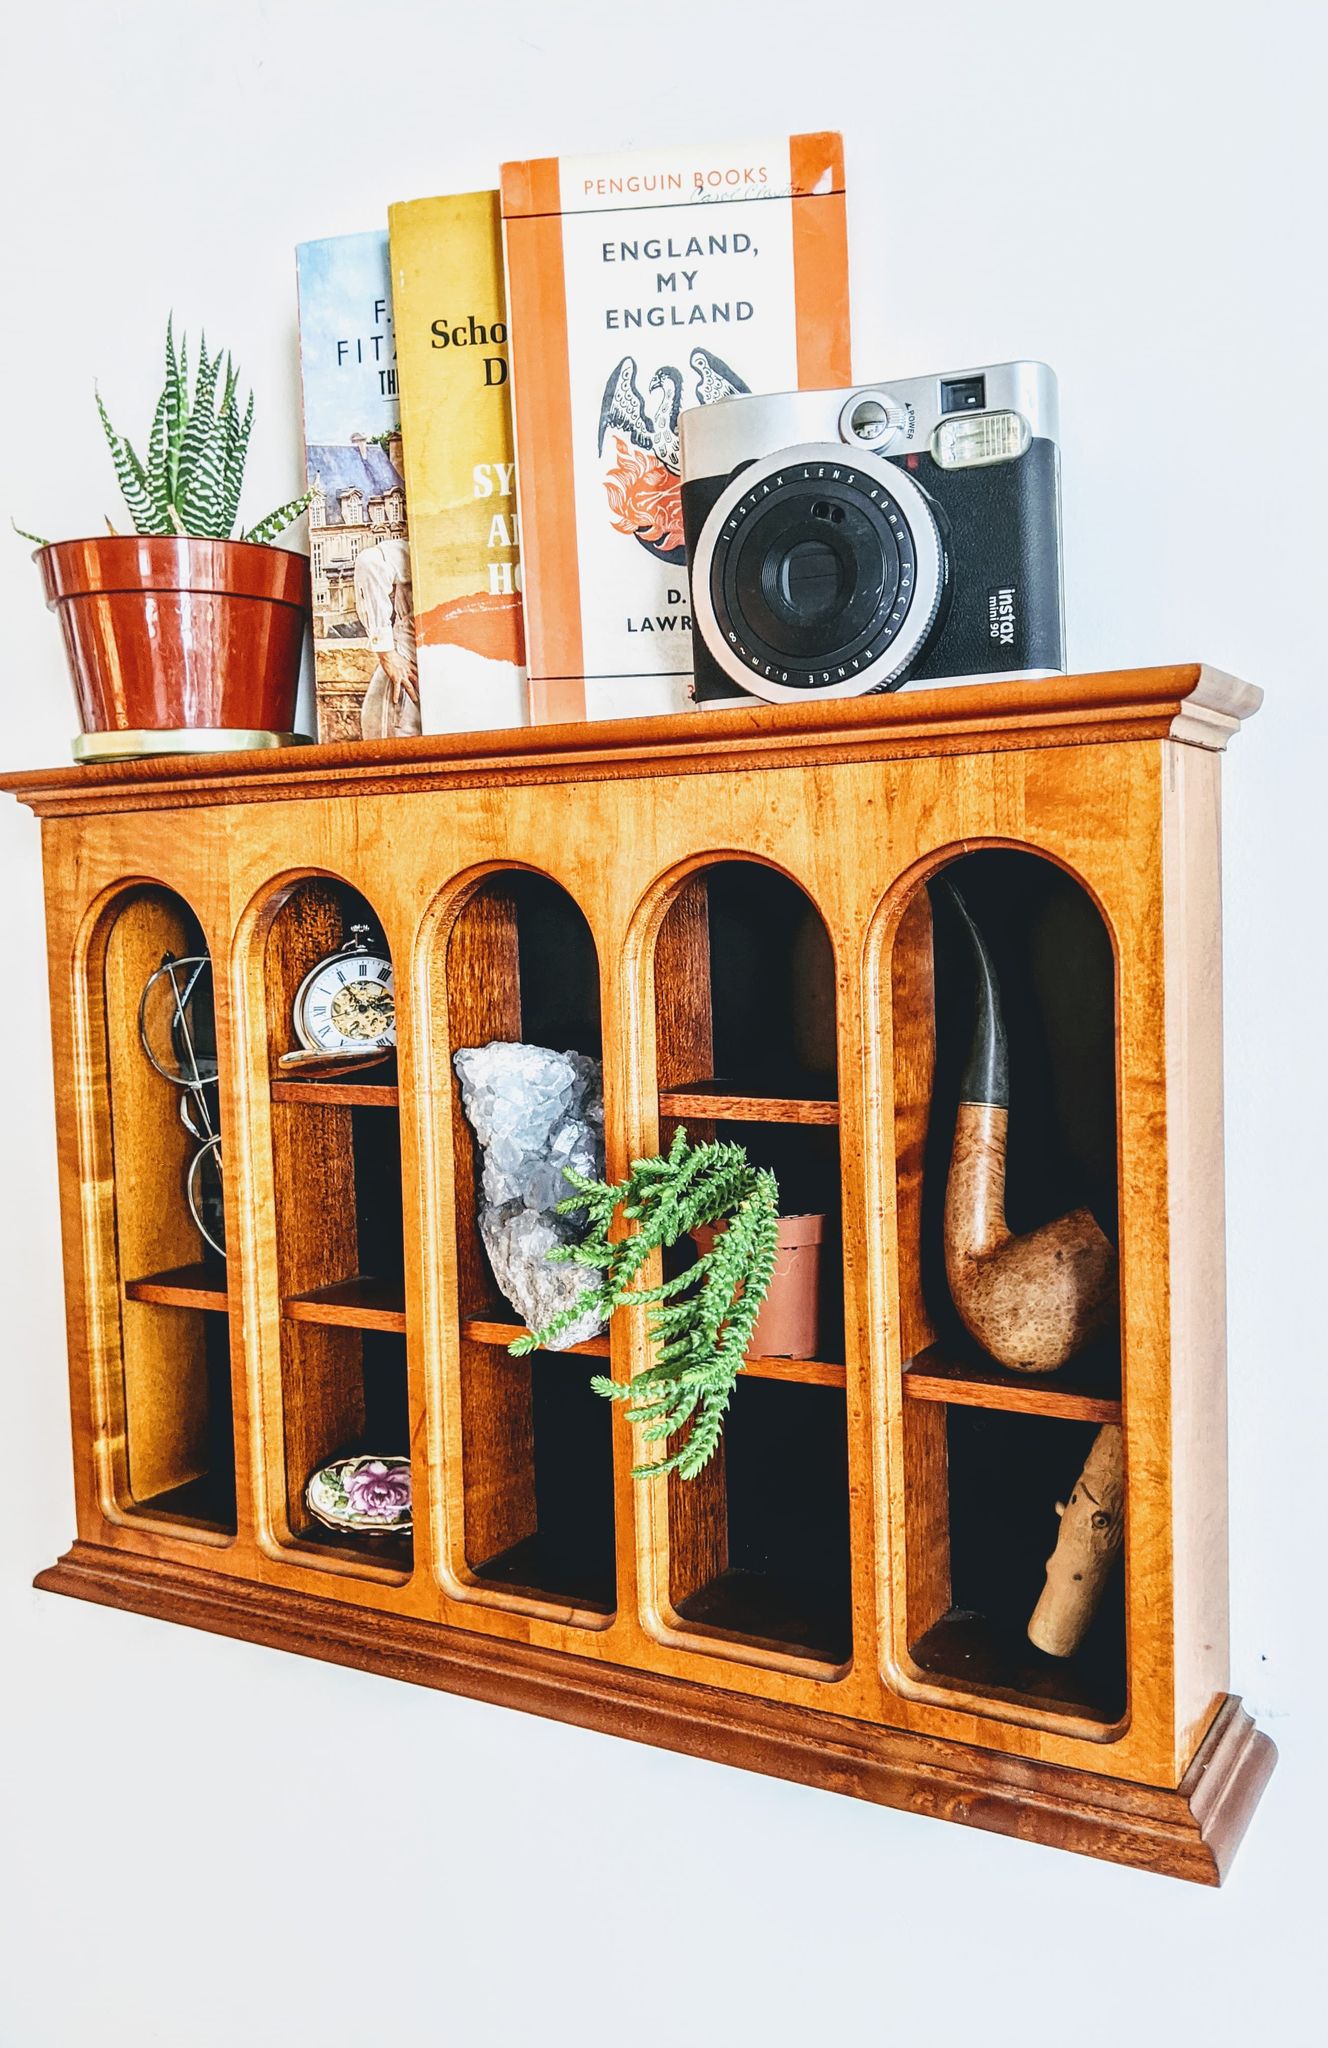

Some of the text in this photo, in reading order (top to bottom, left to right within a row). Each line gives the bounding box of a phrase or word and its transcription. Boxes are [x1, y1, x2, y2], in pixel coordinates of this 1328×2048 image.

[583, 167, 769, 195] PENGUIN BOOKS
[602, 233, 759, 263] ENGLAND,
[656, 270, 698, 293] MY
[374, 299, 391, 324] F.
[605, 301, 754, 330] ENGLAND
[431, 315, 507, 349] Scho
[337, 333, 398, 366] FIT
[378, 368, 400, 396] TH
[482, 357, 508, 387] D
[906, 409, 916, 440] POWER
[473, 462, 515, 498] SY
[804, 468, 856, 484] LENS
[723, 476, 784, 541] INSTAX
[870, 489, 905, 541] 60mm
[667, 589, 687, 604] D.
[884, 562, 911, 636] FOCUS
[627, 615, 692, 632] LAWR
[988, 596, 1000, 638] mini 90
[998, 588, 1016, 645] instax
[808, 649, 873, 684] RANGE
